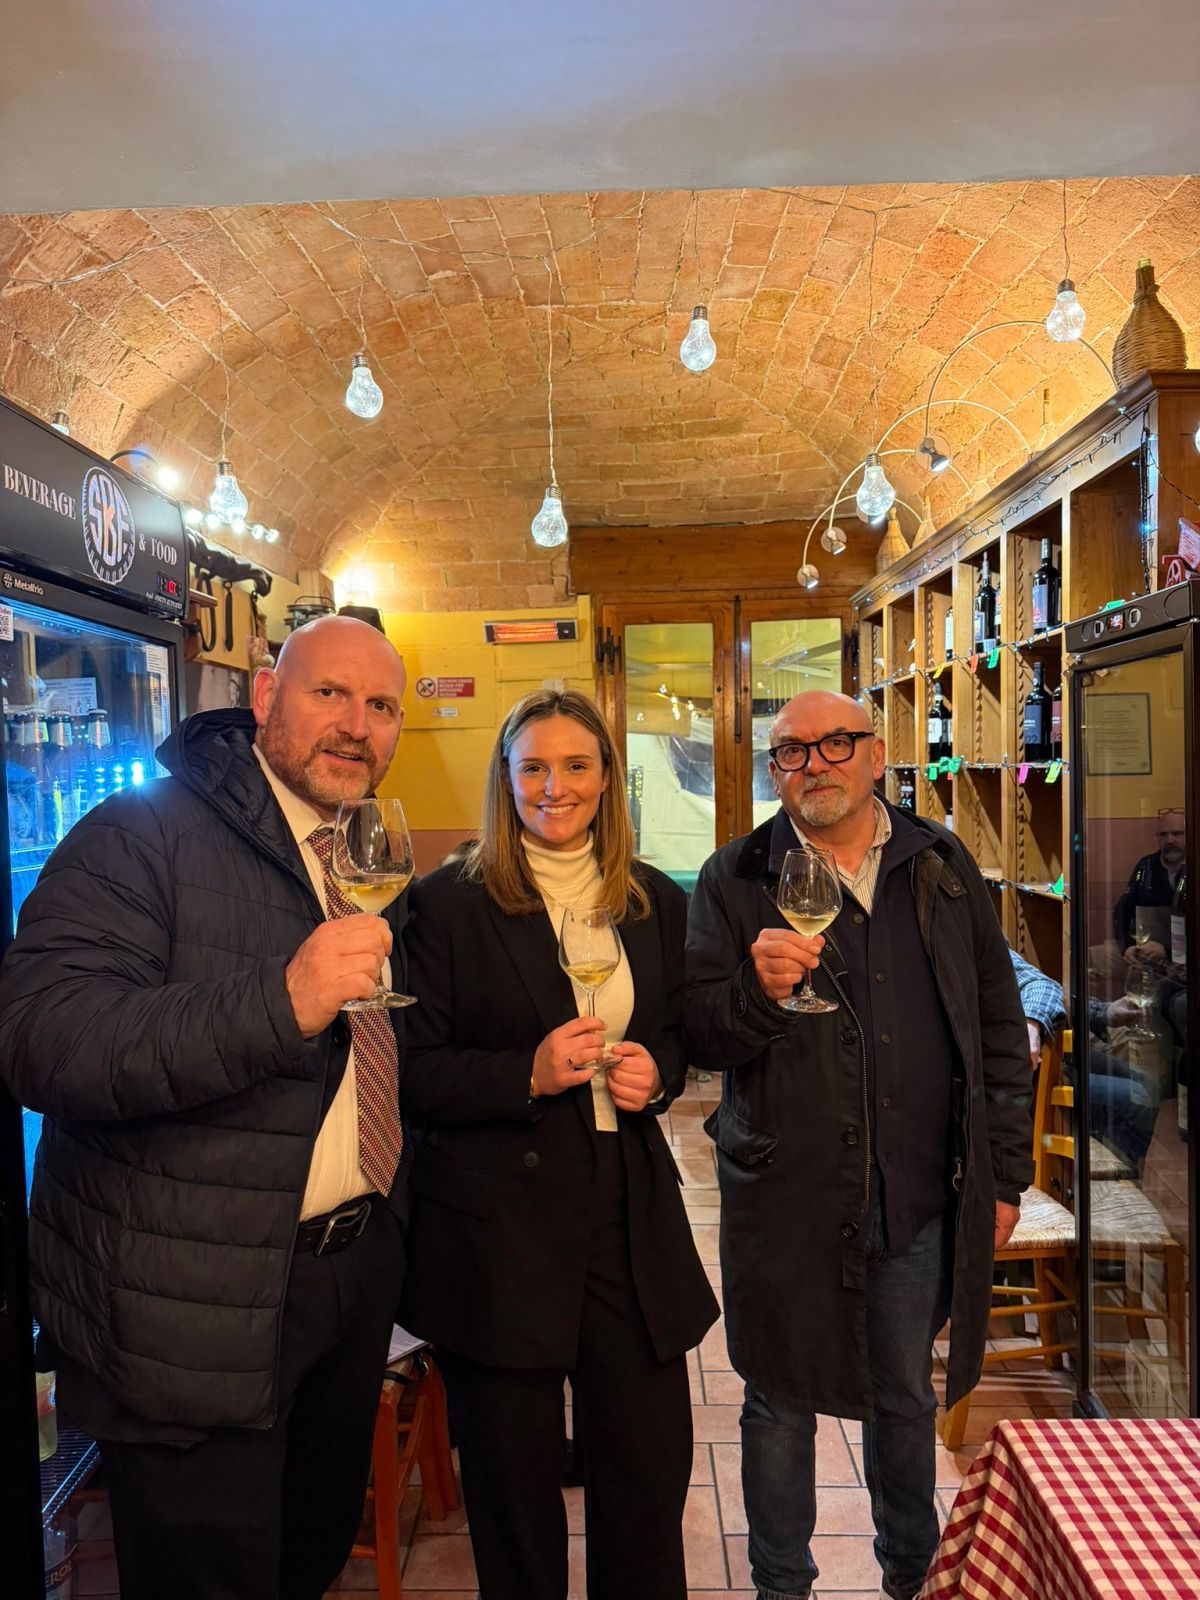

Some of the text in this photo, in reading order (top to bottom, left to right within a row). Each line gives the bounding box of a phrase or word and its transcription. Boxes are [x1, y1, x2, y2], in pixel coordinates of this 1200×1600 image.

[3, 464, 178, 566] BEVERAGE & FOOD
[14, 578, 44, 596] Metalfrio
